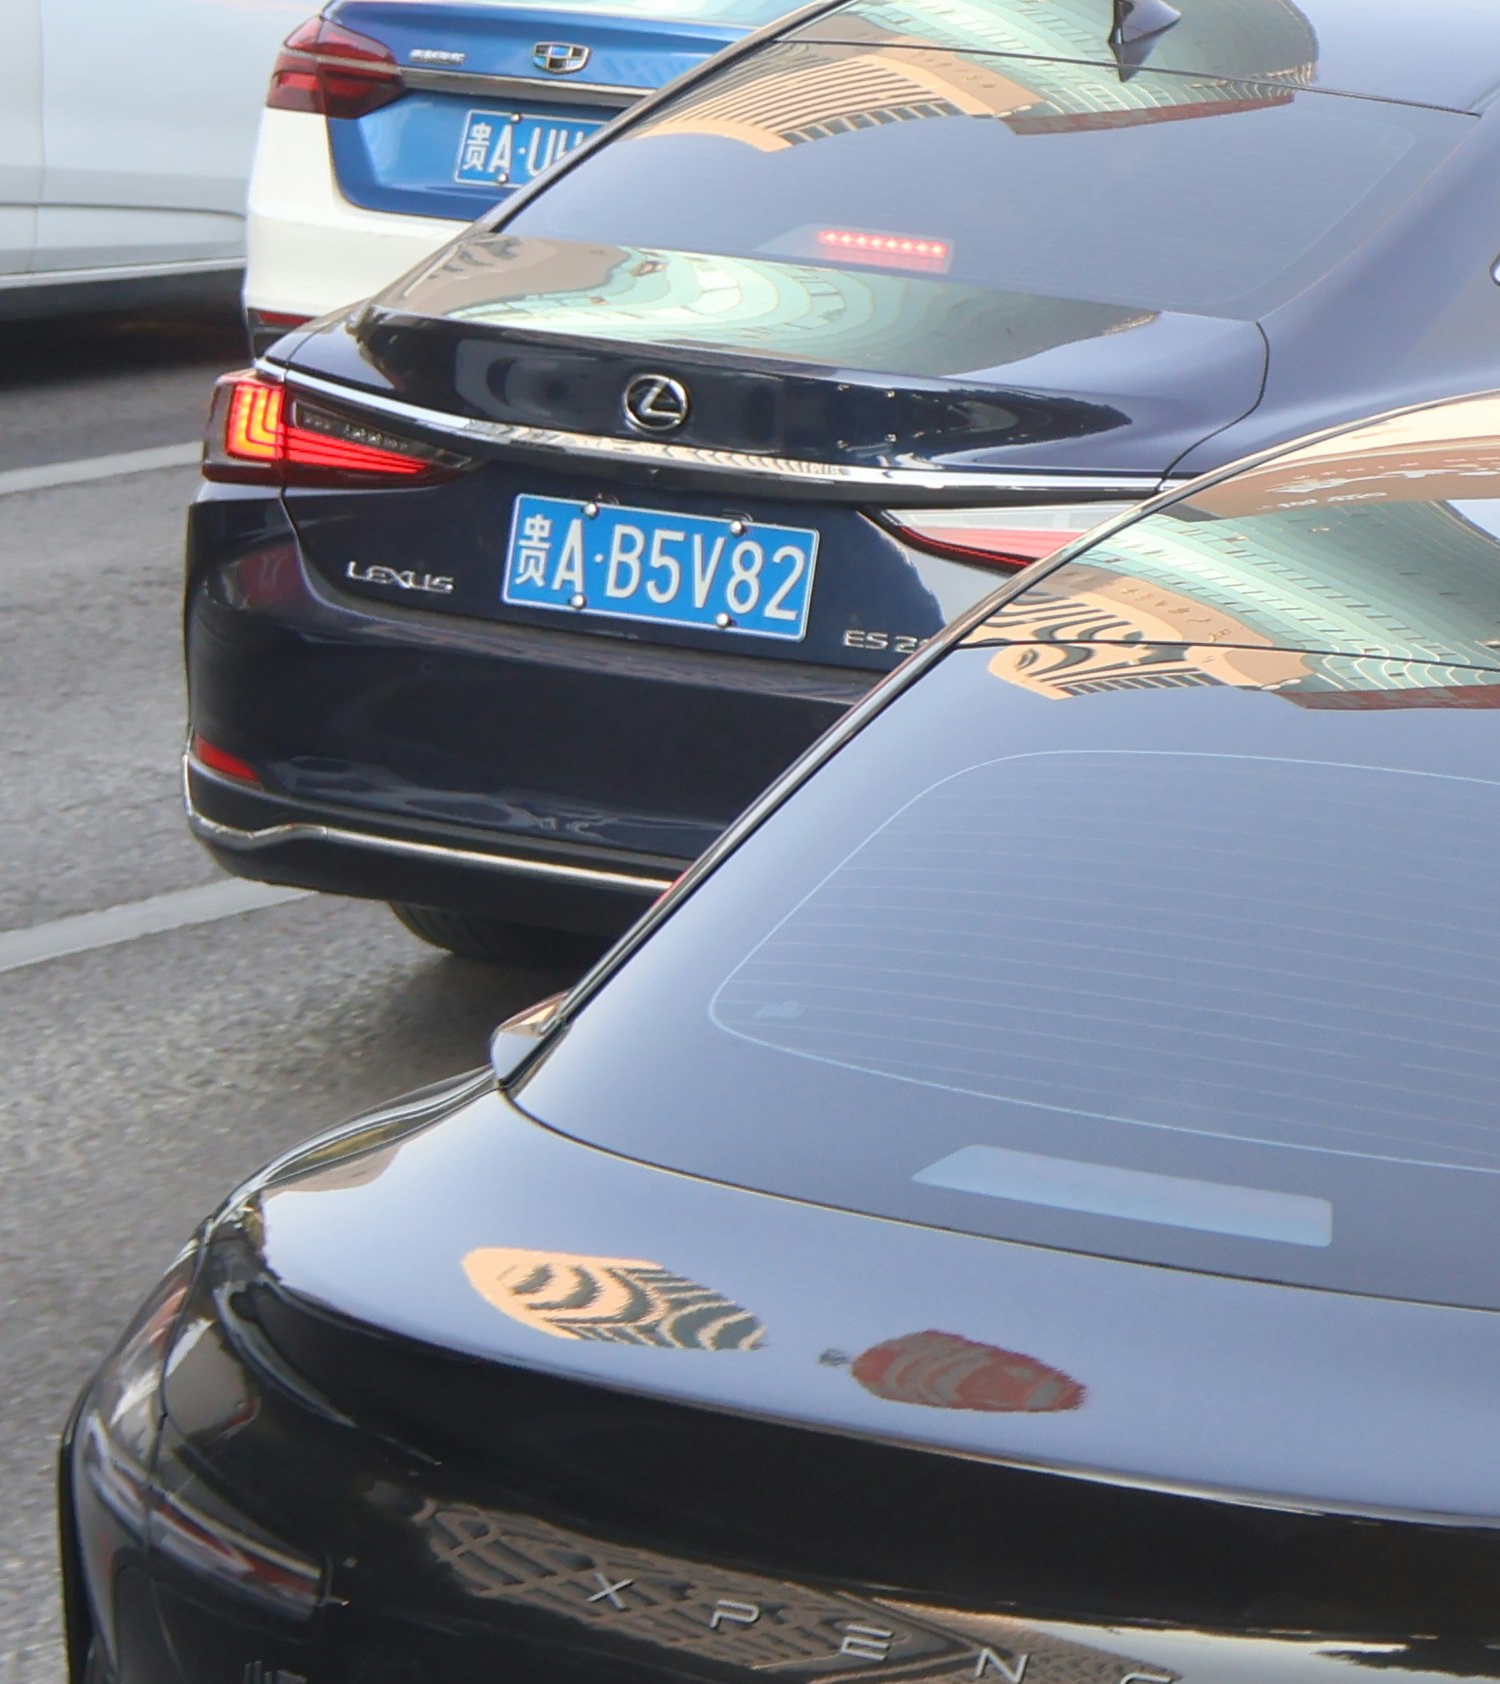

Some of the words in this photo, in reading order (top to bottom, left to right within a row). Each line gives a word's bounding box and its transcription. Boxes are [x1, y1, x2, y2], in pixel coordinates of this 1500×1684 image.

[346, 561, 454, 594] LEXUS
[514, 511, 808, 622] 贵A·B5V82
[844, 629, 888, 650] ES
[894, 635, 930, 654] 2
